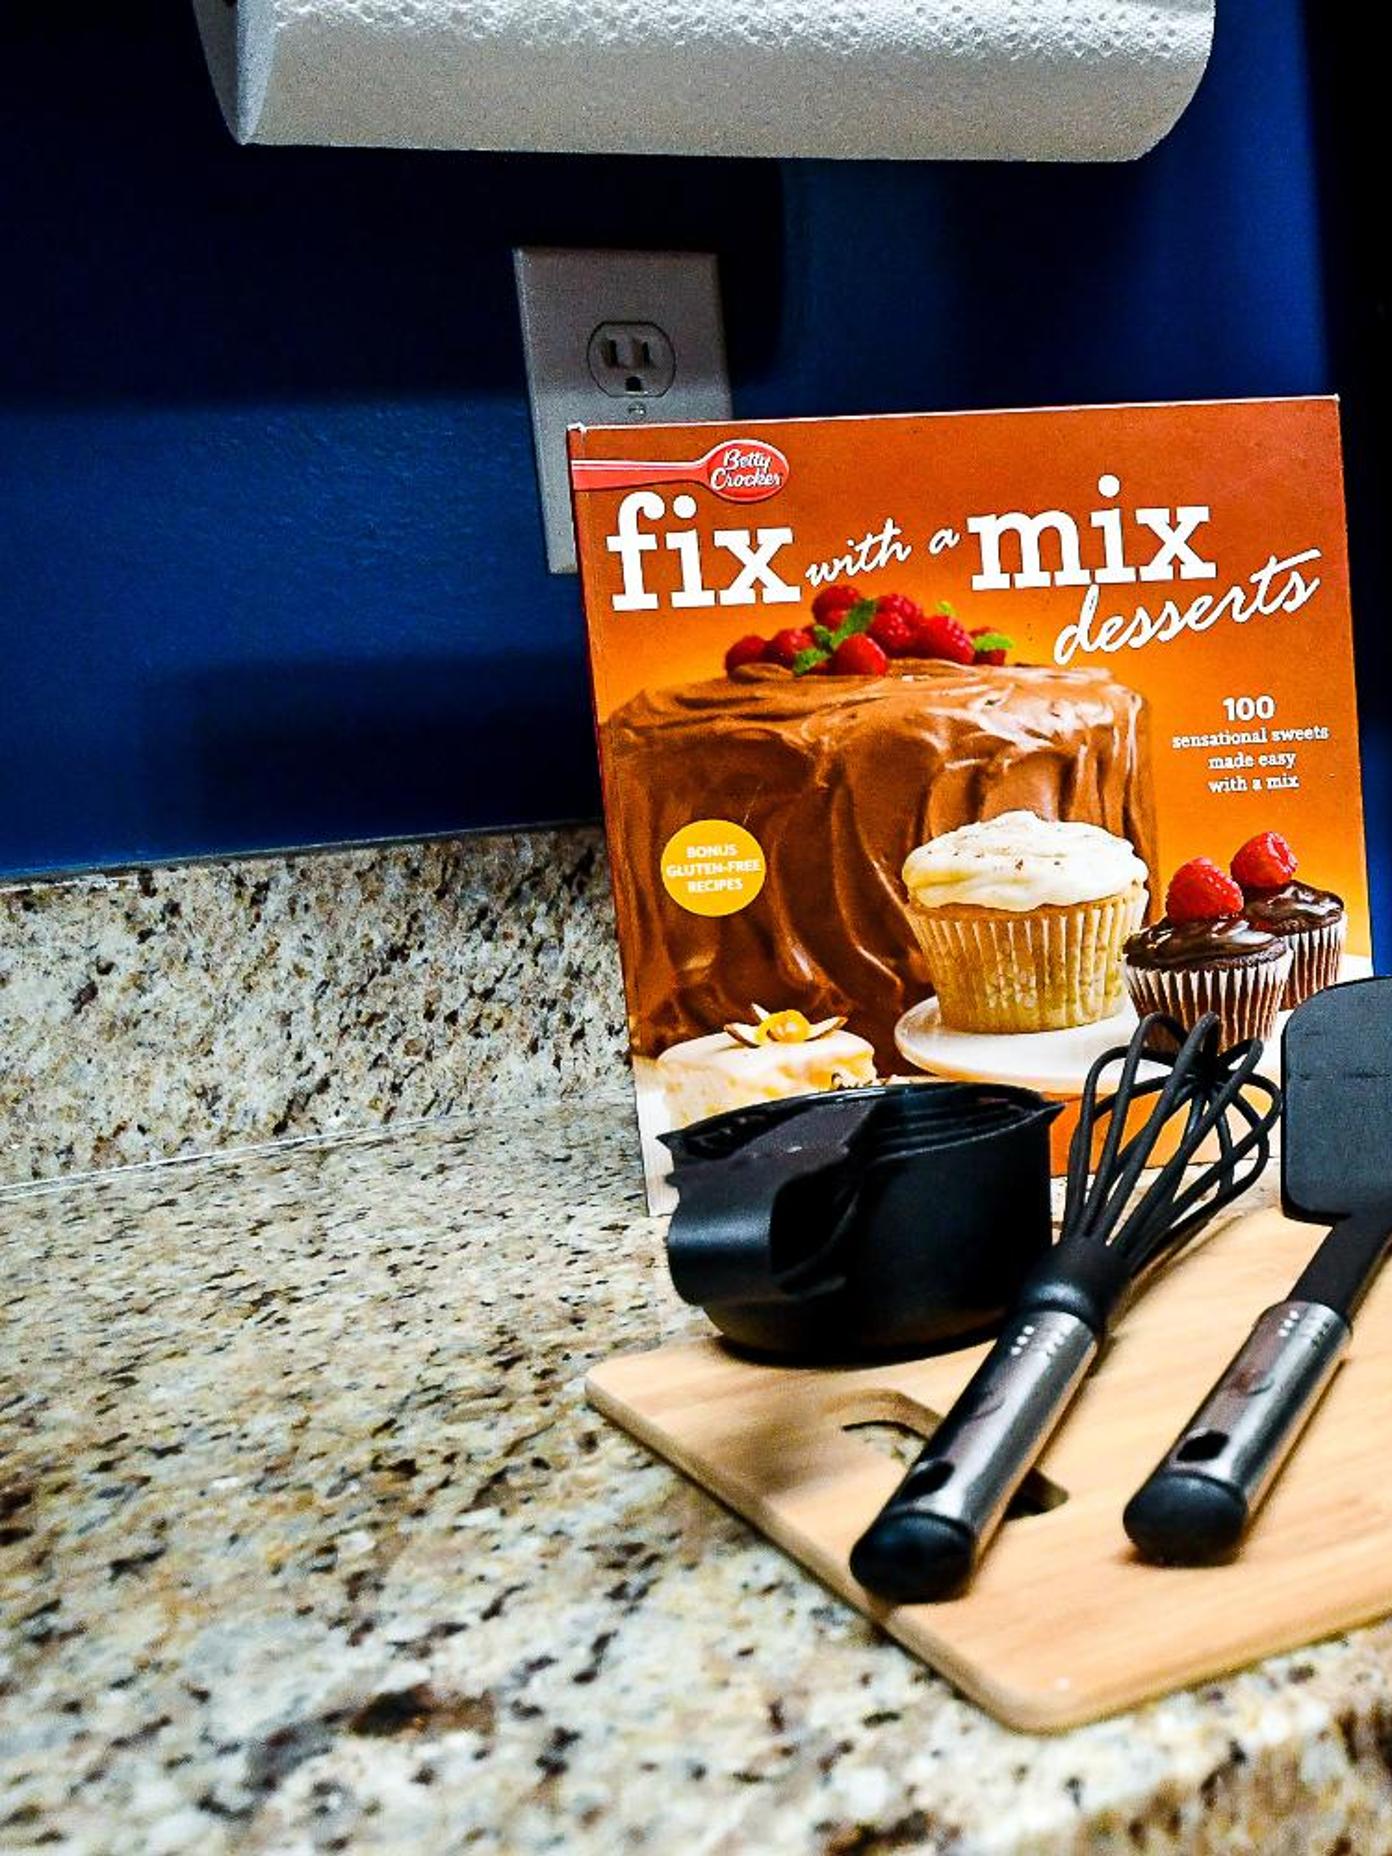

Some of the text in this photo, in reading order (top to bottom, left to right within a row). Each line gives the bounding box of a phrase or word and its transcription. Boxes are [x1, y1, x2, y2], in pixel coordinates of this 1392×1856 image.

[723, 449, 771, 471] Betty
[710, 467, 780, 490] Crocker
[606, 474, 1218, 612] fix with a mix
[1053, 548, 1322, 666] desserts
[1222, 695, 1276, 721] 100
[1172, 725, 1329, 748] sensational sweets
[1208, 752, 1297, 769] made easy
[1208, 773, 1299, 793] with a mix
[686, 844, 738, 859] BONUS
[666, 859, 761, 878] GLUTEN-FREE
[687, 878, 744, 893] RECIPES
